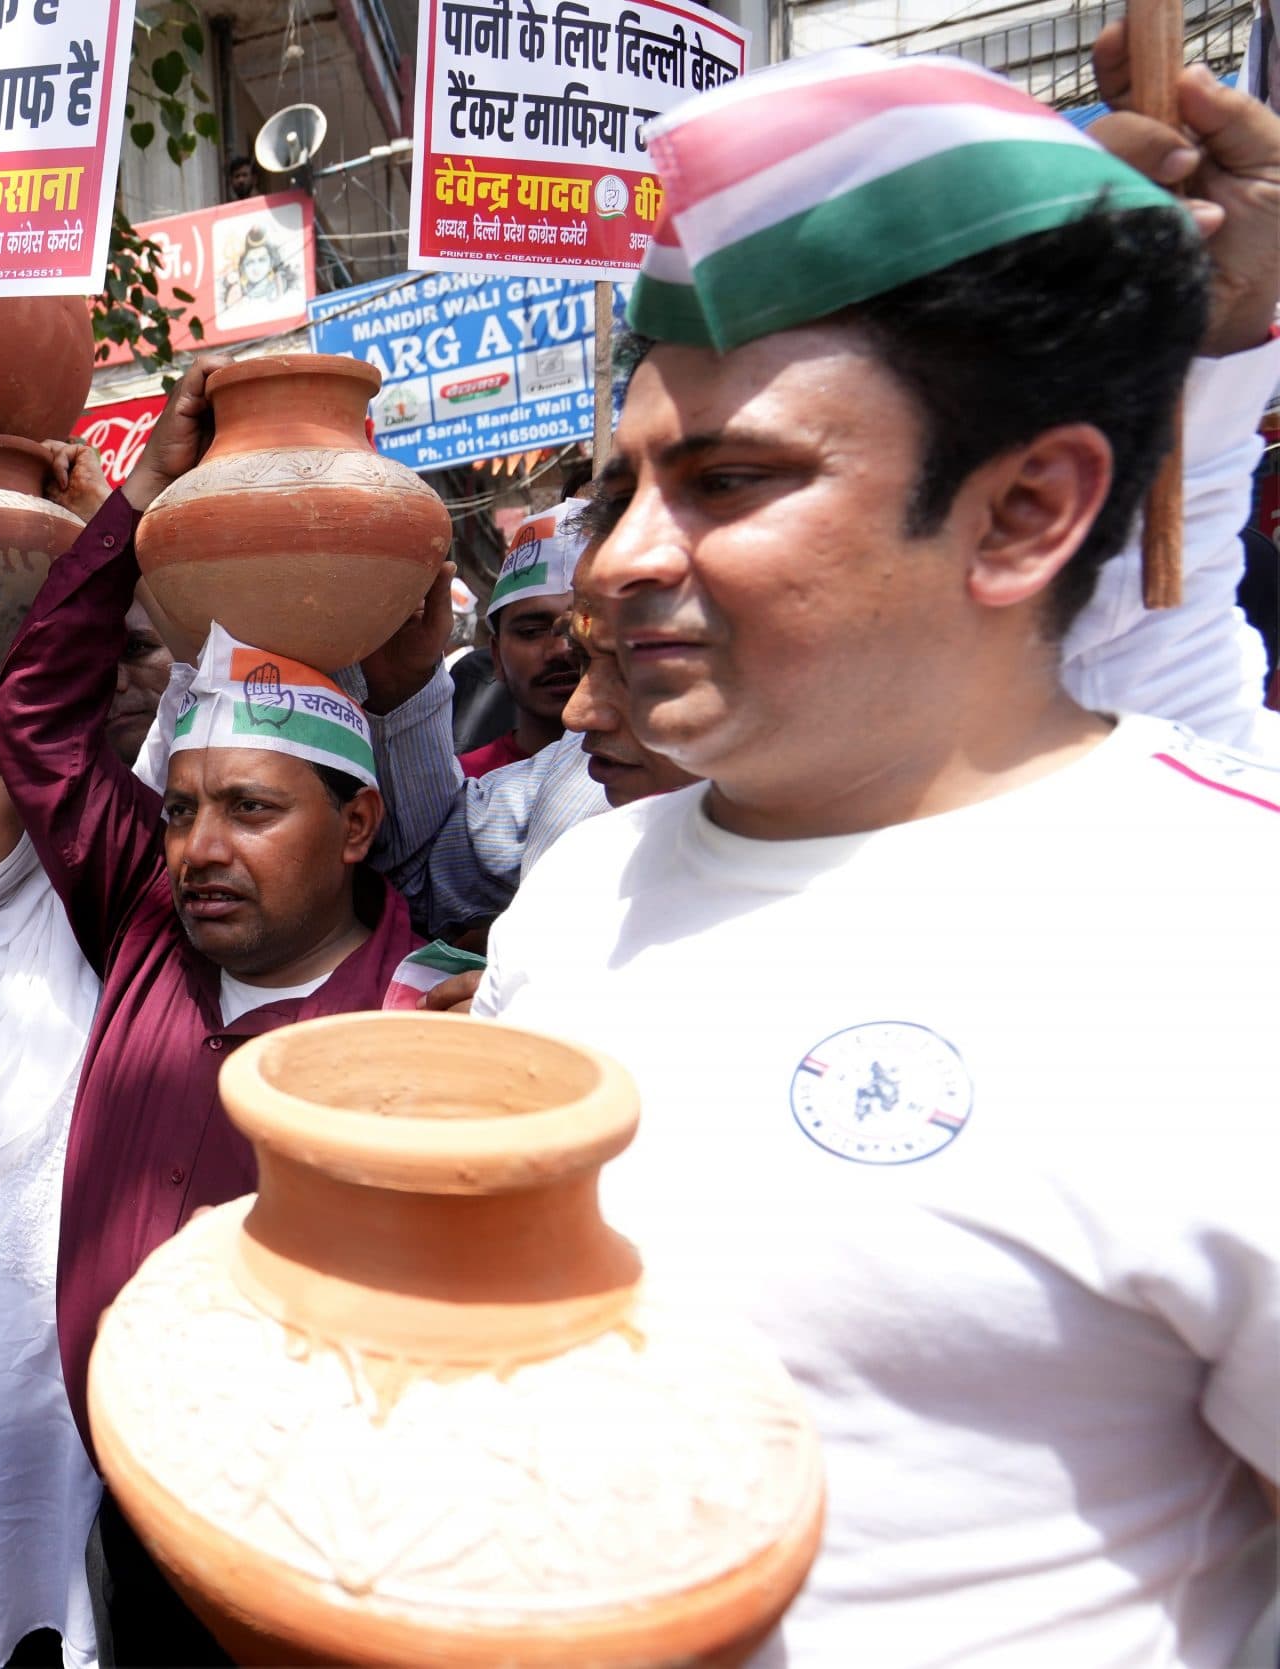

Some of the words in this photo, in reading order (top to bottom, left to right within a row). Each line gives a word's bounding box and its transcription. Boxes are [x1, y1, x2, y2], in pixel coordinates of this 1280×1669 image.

[442, 0, 513, 60] पानी
[516, 0, 548, 63] के
[552, 1, 612, 72] लिए
[615, 10, 687, 89] दिल्ली
[67, 39, 100, 127] है
[447, 69, 519, 143] टैंकर
[523, 82, 630, 154] माफिया
[434, 157, 513, 213] देवेन्द्र
[517, 173, 593, 214] यादव
[6, 221, 44, 255] कांग्रेस
[47, 218, 84, 253] कमेटी
[472, 213, 501, 242] दिल्ली
[503, 215, 526, 244] प्रदेश
[528, 217, 557, 245] कांग्रेस
[559, 219, 588, 247] कमेटी
[439, 249, 485, 260] PRINTED
[486, 253, 503, 261] BY-
[504, 254, 553, 264] CREATIVE
[555, 256, 582, 265] LAND
[583, 259, 646, 269] ADVERTISIN
[352, 305, 439, 343] MANDIR
[443, 288, 501, 319] WALI
[335, 325, 462, 381] ARG
[379, 428, 422, 451] Yusuf
[476, 406, 532, 431] Mandir
[535, 396, 571, 418] Wali
[297, 693, 363, 734] सत्यमेव
